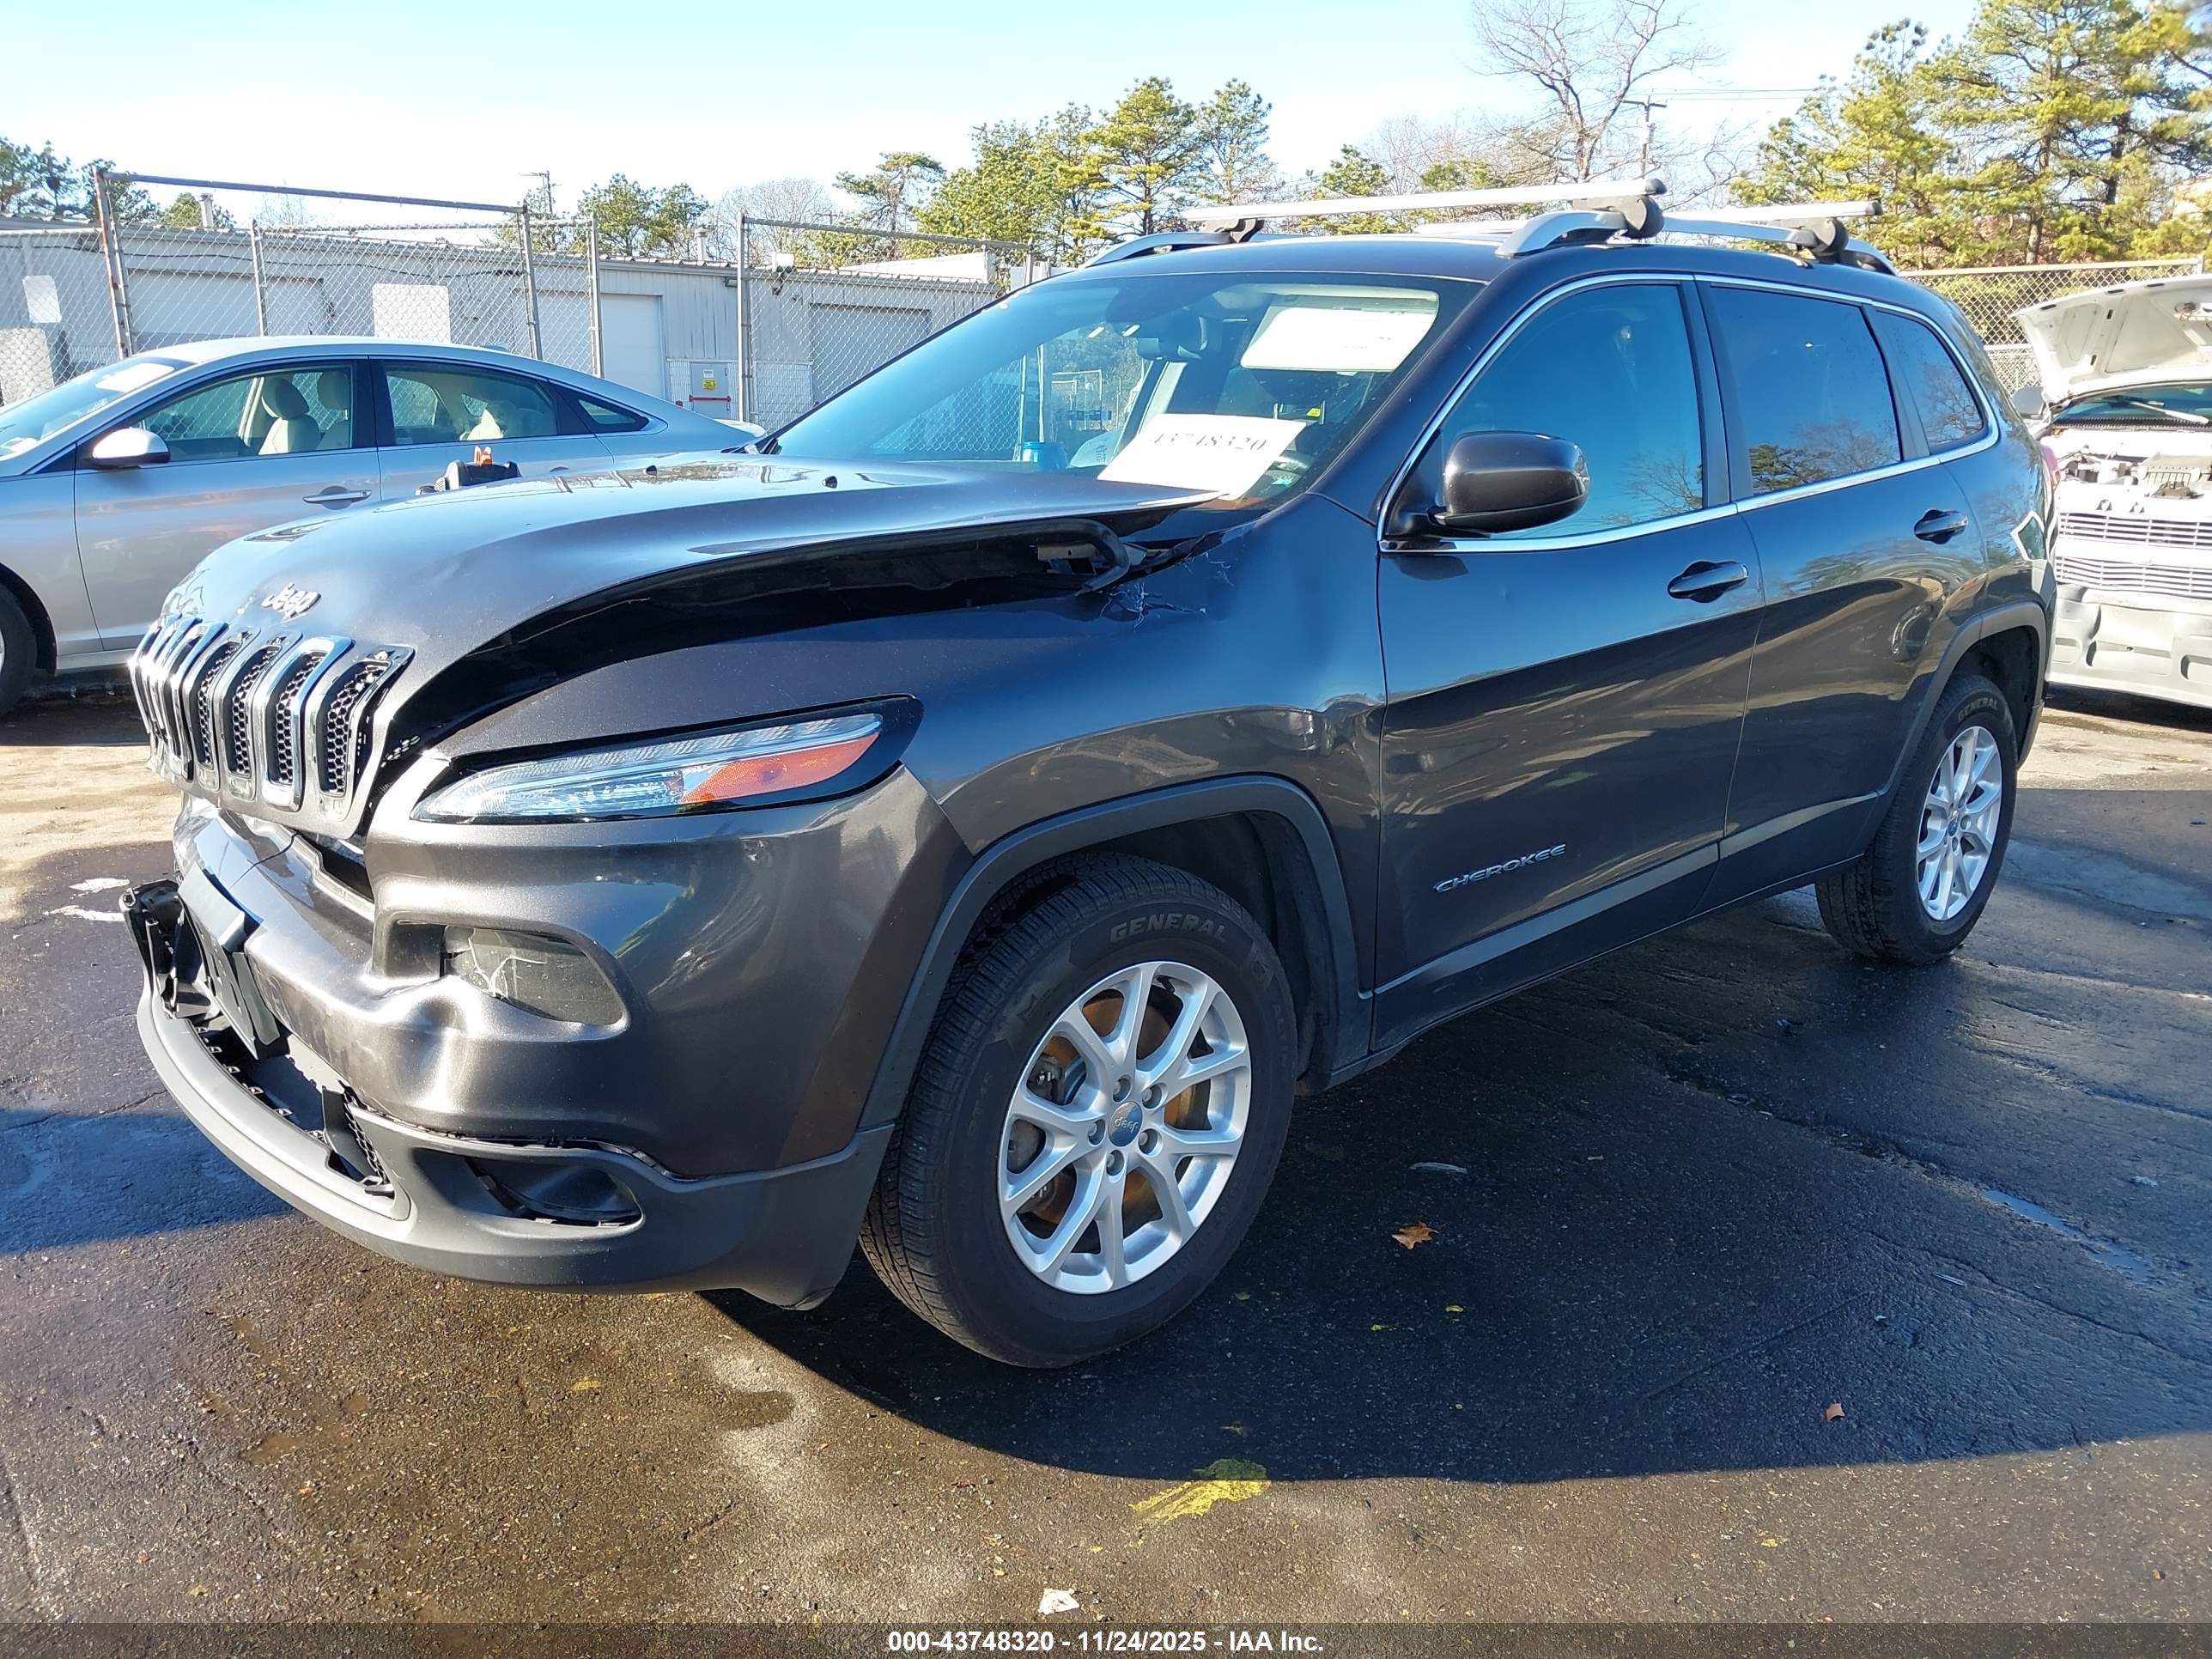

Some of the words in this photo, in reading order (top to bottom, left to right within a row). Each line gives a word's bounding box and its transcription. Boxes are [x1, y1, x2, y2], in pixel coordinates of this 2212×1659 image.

[260, 583, 322, 618] Jeep
[1957, 696, 1998, 723] GENERAL
[1433, 843, 1566, 893] CHEROKEE
[1109, 912, 1228, 944] GENERAL
